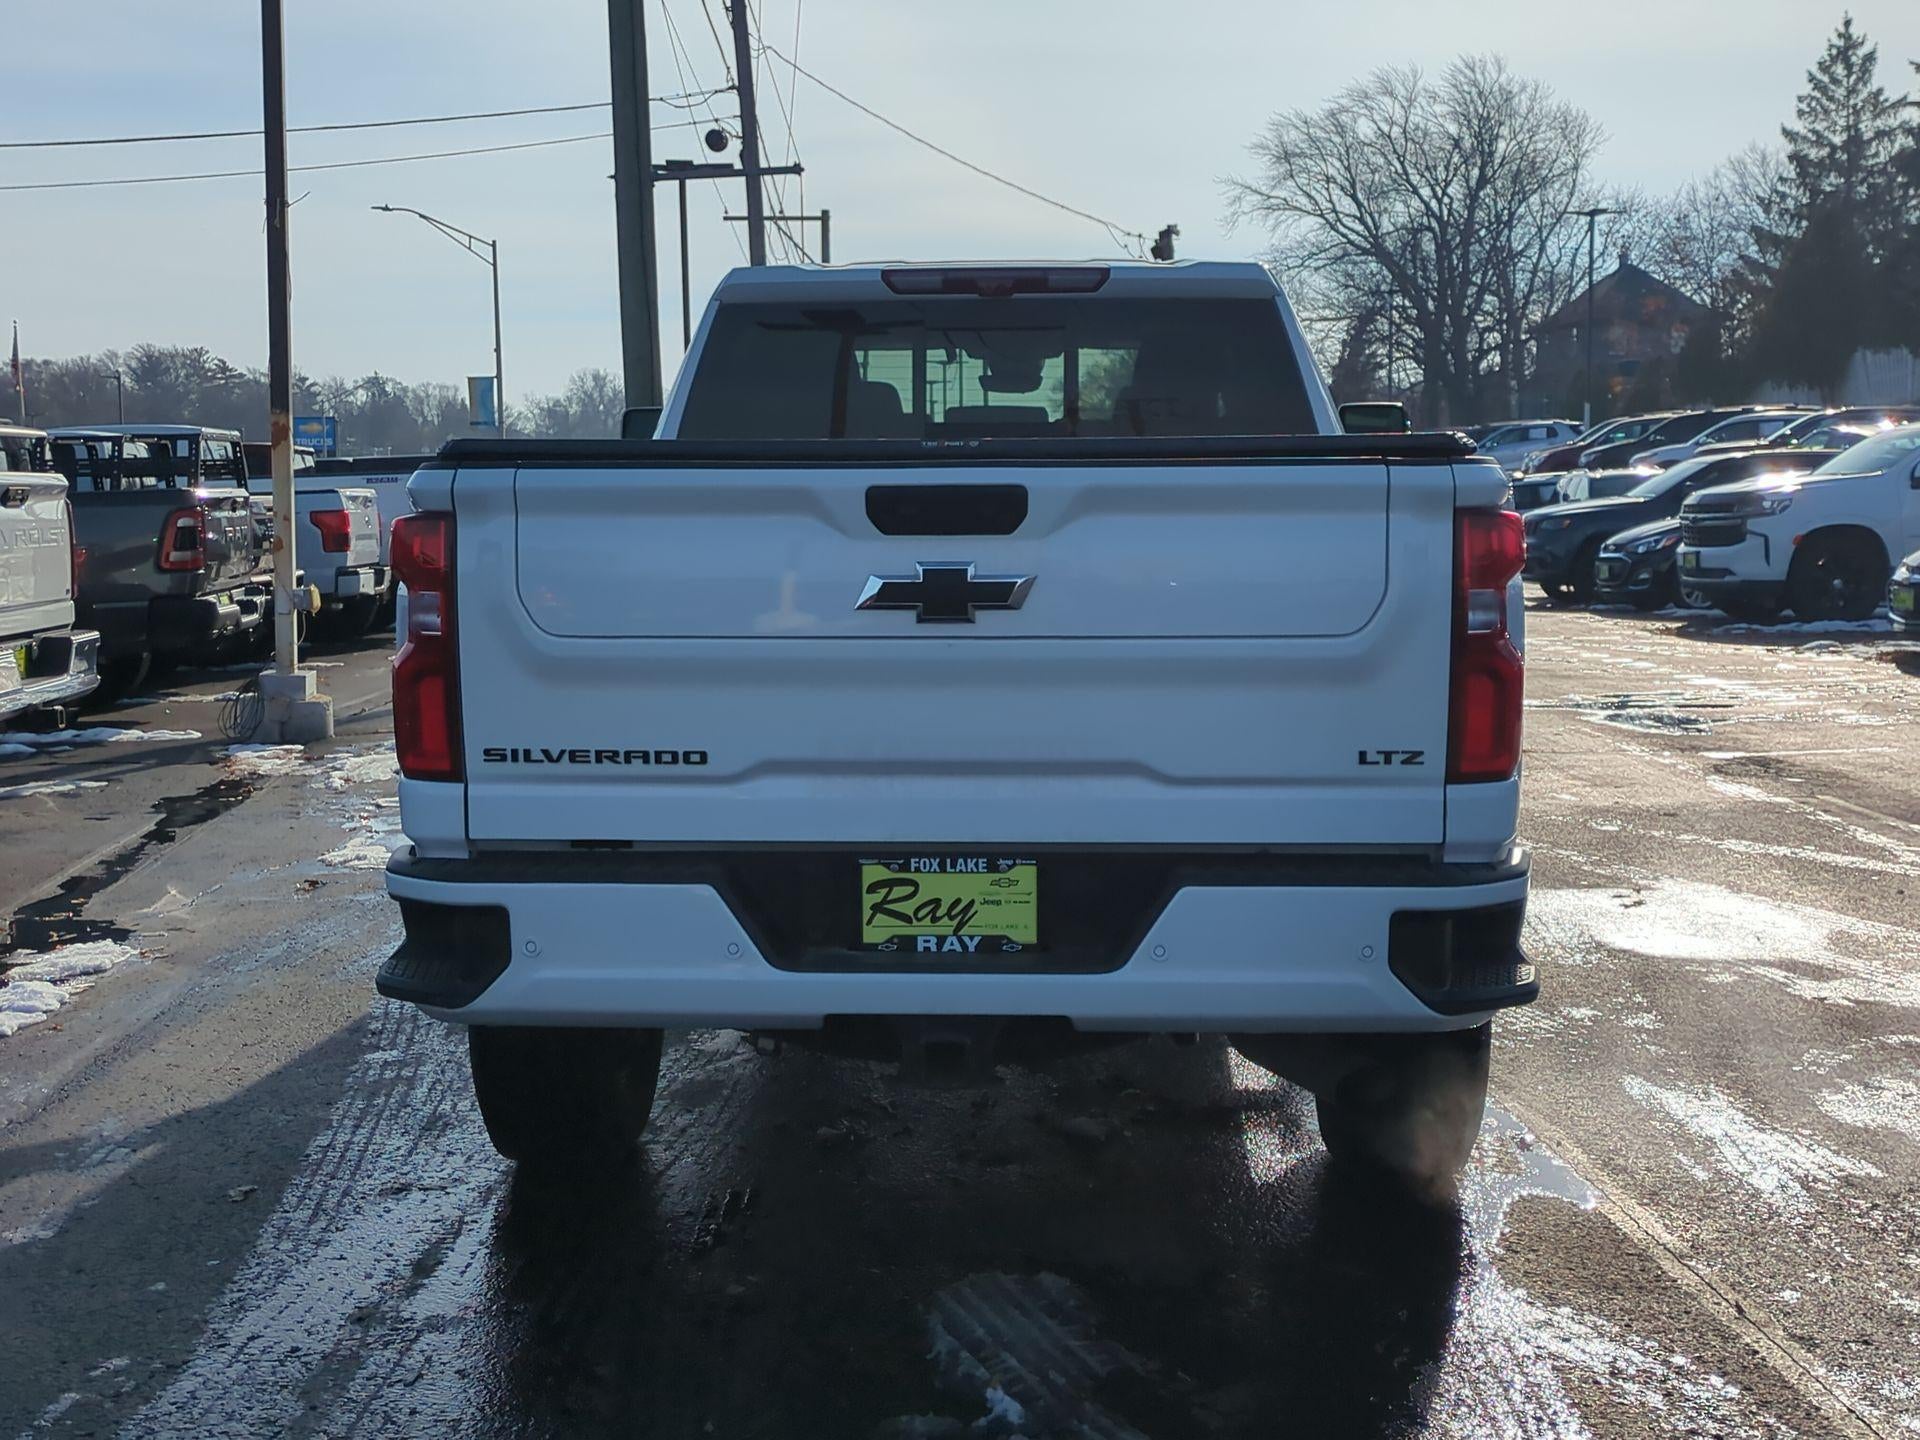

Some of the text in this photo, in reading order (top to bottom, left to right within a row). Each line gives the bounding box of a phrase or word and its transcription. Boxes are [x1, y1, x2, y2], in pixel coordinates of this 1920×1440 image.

[483, 747, 708, 765] SILVERADO
[1358, 750, 1425, 765] LTZ
[910, 857, 988, 873] FOX LAKE
[865, 877, 978, 936] Ray
[916, 936, 982, 952] RAY
